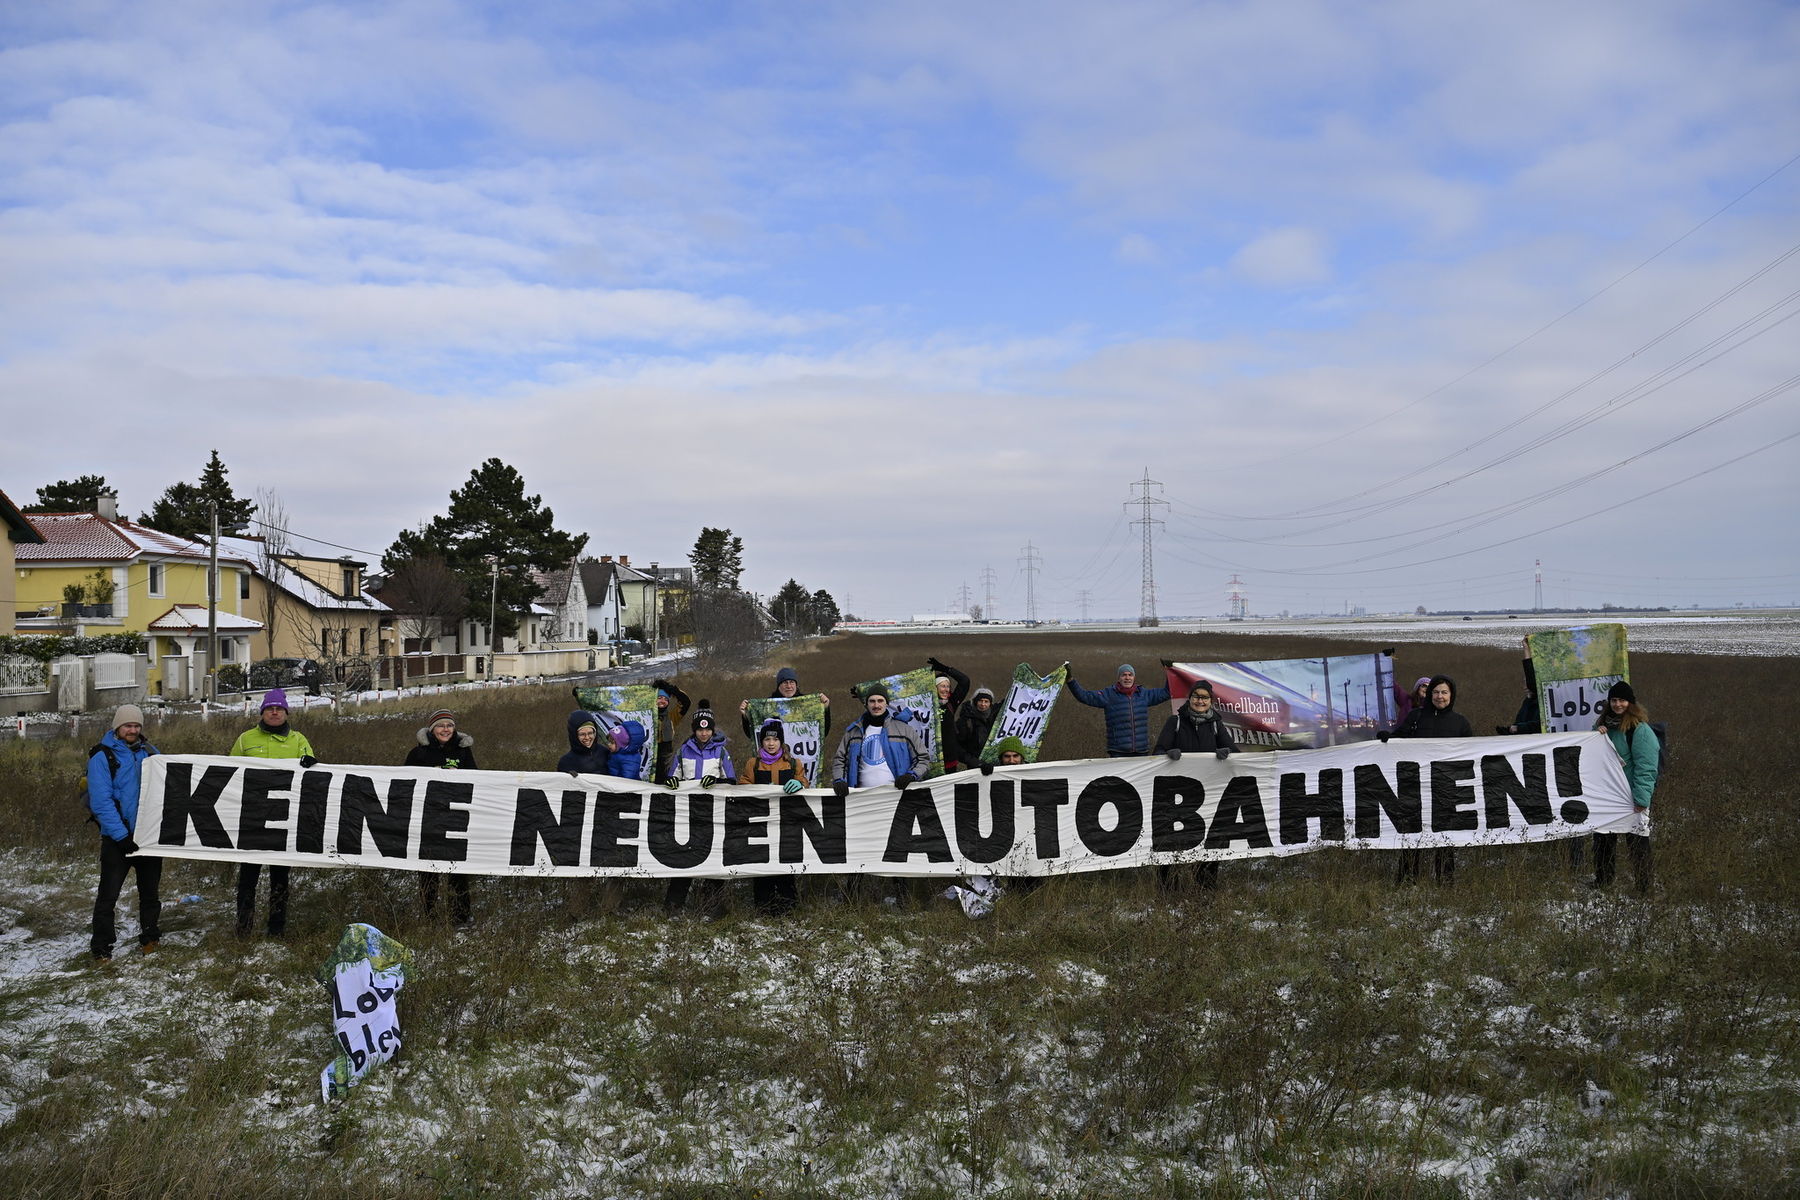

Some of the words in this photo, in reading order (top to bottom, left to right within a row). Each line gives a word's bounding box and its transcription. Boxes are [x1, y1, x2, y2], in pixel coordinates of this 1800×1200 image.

[1213, 697, 1279, 714] chnellbahn
[1548, 686, 1608, 718] Loba
[1224, 724, 1283, 747] BAHN
[158, 762, 473, 861] KEINE
[509, 788, 847, 869] NEUEN
[882, 746, 1590, 863] AUTOBAHNEN!
